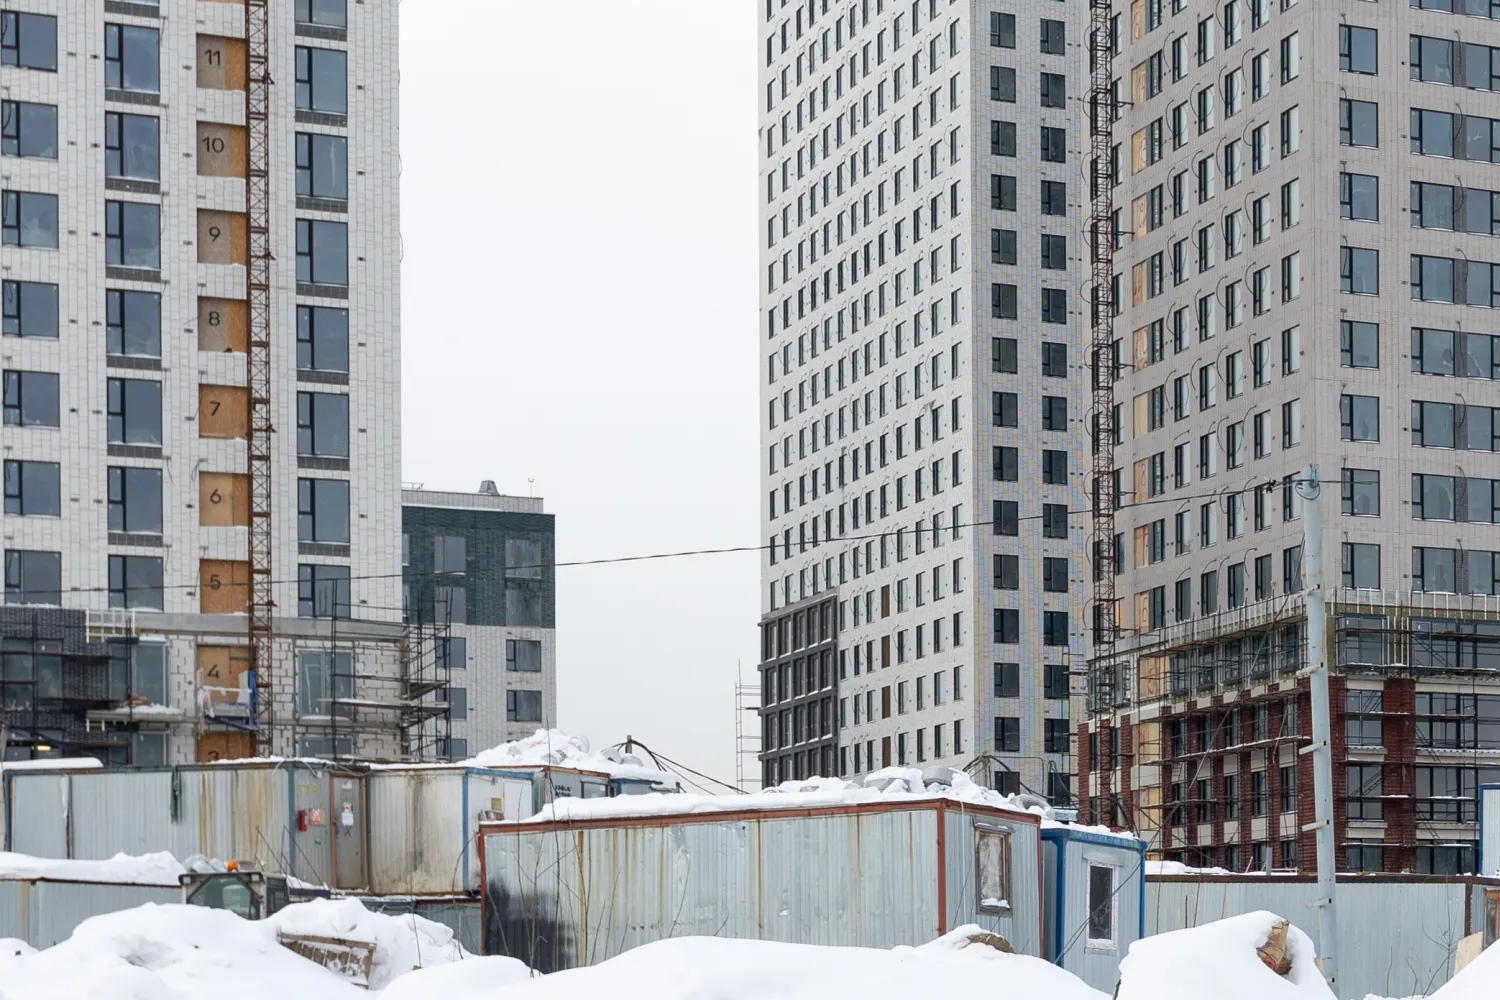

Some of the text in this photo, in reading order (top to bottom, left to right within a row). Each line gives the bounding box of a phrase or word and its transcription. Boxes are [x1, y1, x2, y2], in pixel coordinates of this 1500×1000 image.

[204, 50, 220, 66] 11
[203, 137, 224, 152] 10
[209, 226, 220, 242] 9
[209, 311, 220, 327] 8
[210, 401, 220, 417] 7
[210, 489, 221, 504] 6
[209, 575, 221, 590] 5
[207, 664, 219, 680] 4
